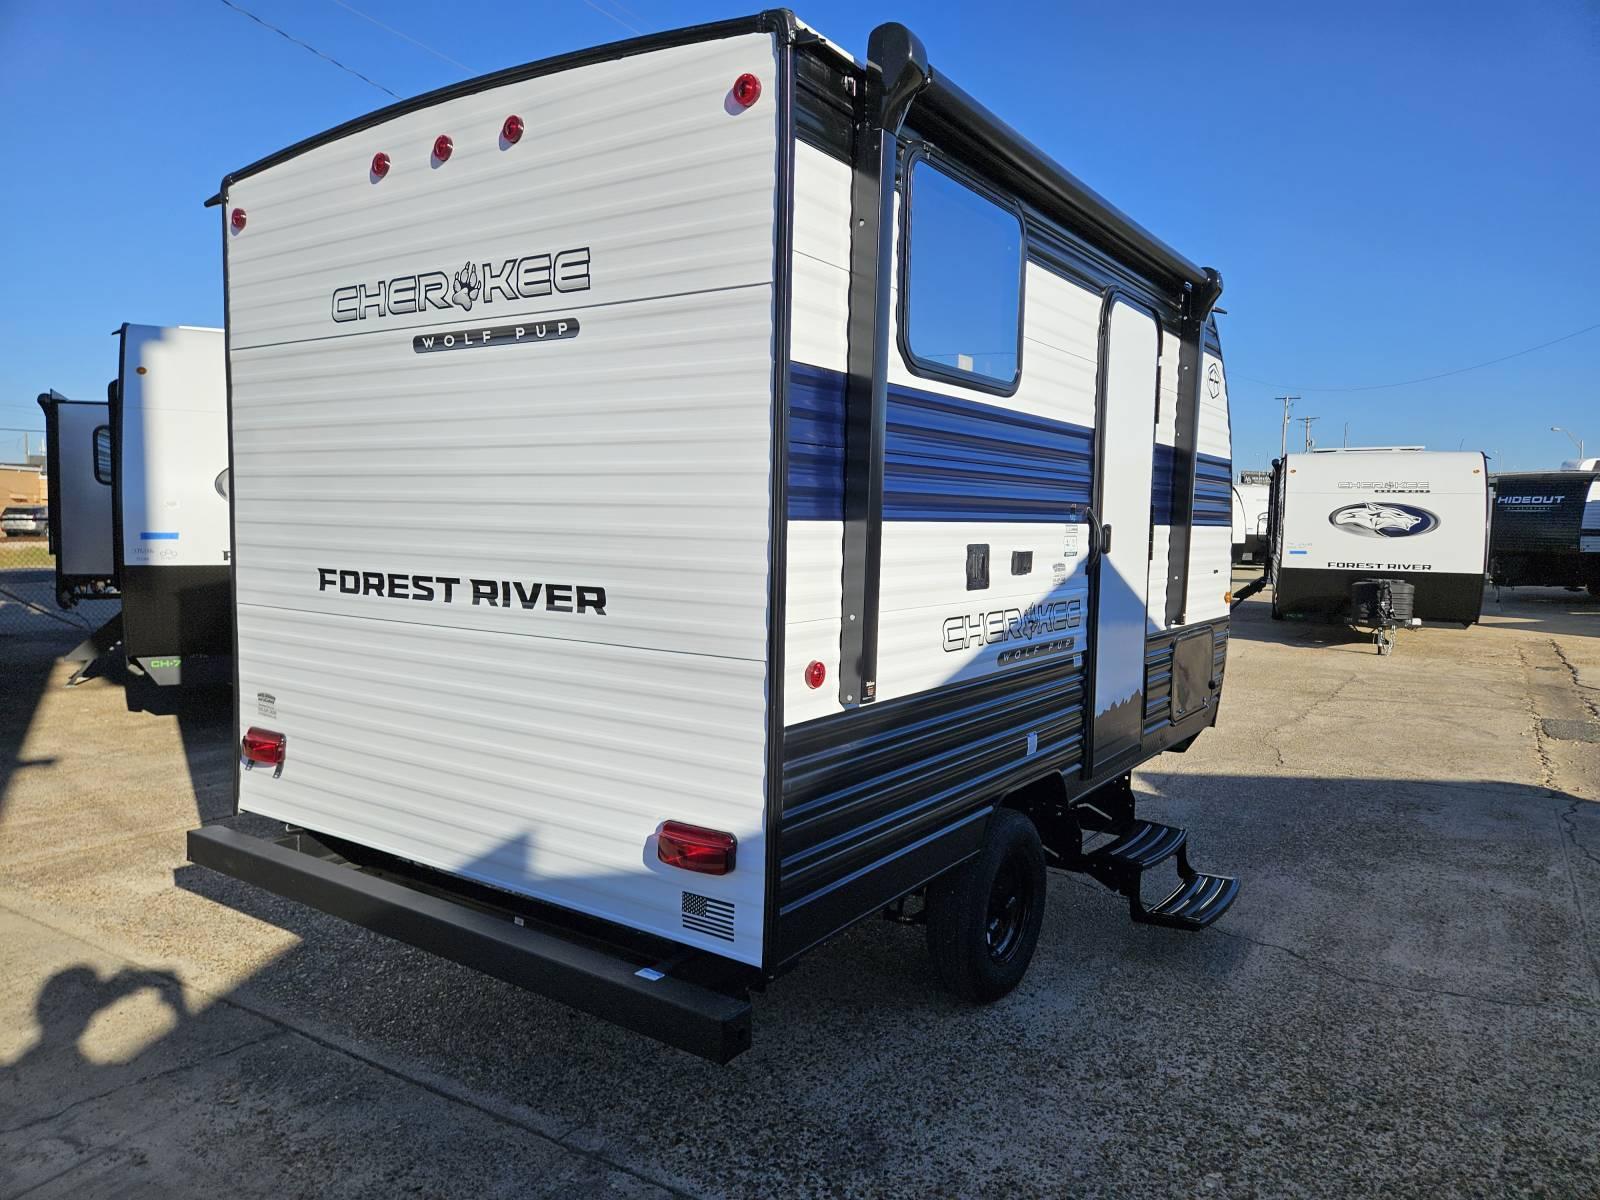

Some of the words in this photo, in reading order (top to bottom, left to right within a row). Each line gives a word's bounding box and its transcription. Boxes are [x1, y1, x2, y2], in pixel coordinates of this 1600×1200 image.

[422, 330, 491, 348] WOLF
[515, 322, 568, 339] PUP
[1497, 495, 1565, 504] HIDEOUT
[1327, 561, 1384, 569] FOREST
[1388, 563, 1432, 571] RIVER
[317, 568, 460, 603] FOREST
[469, 578, 607, 616] RIVER
[1003, 645, 1040, 661] WOLF
[1048, 639, 1071, 652] PUP
